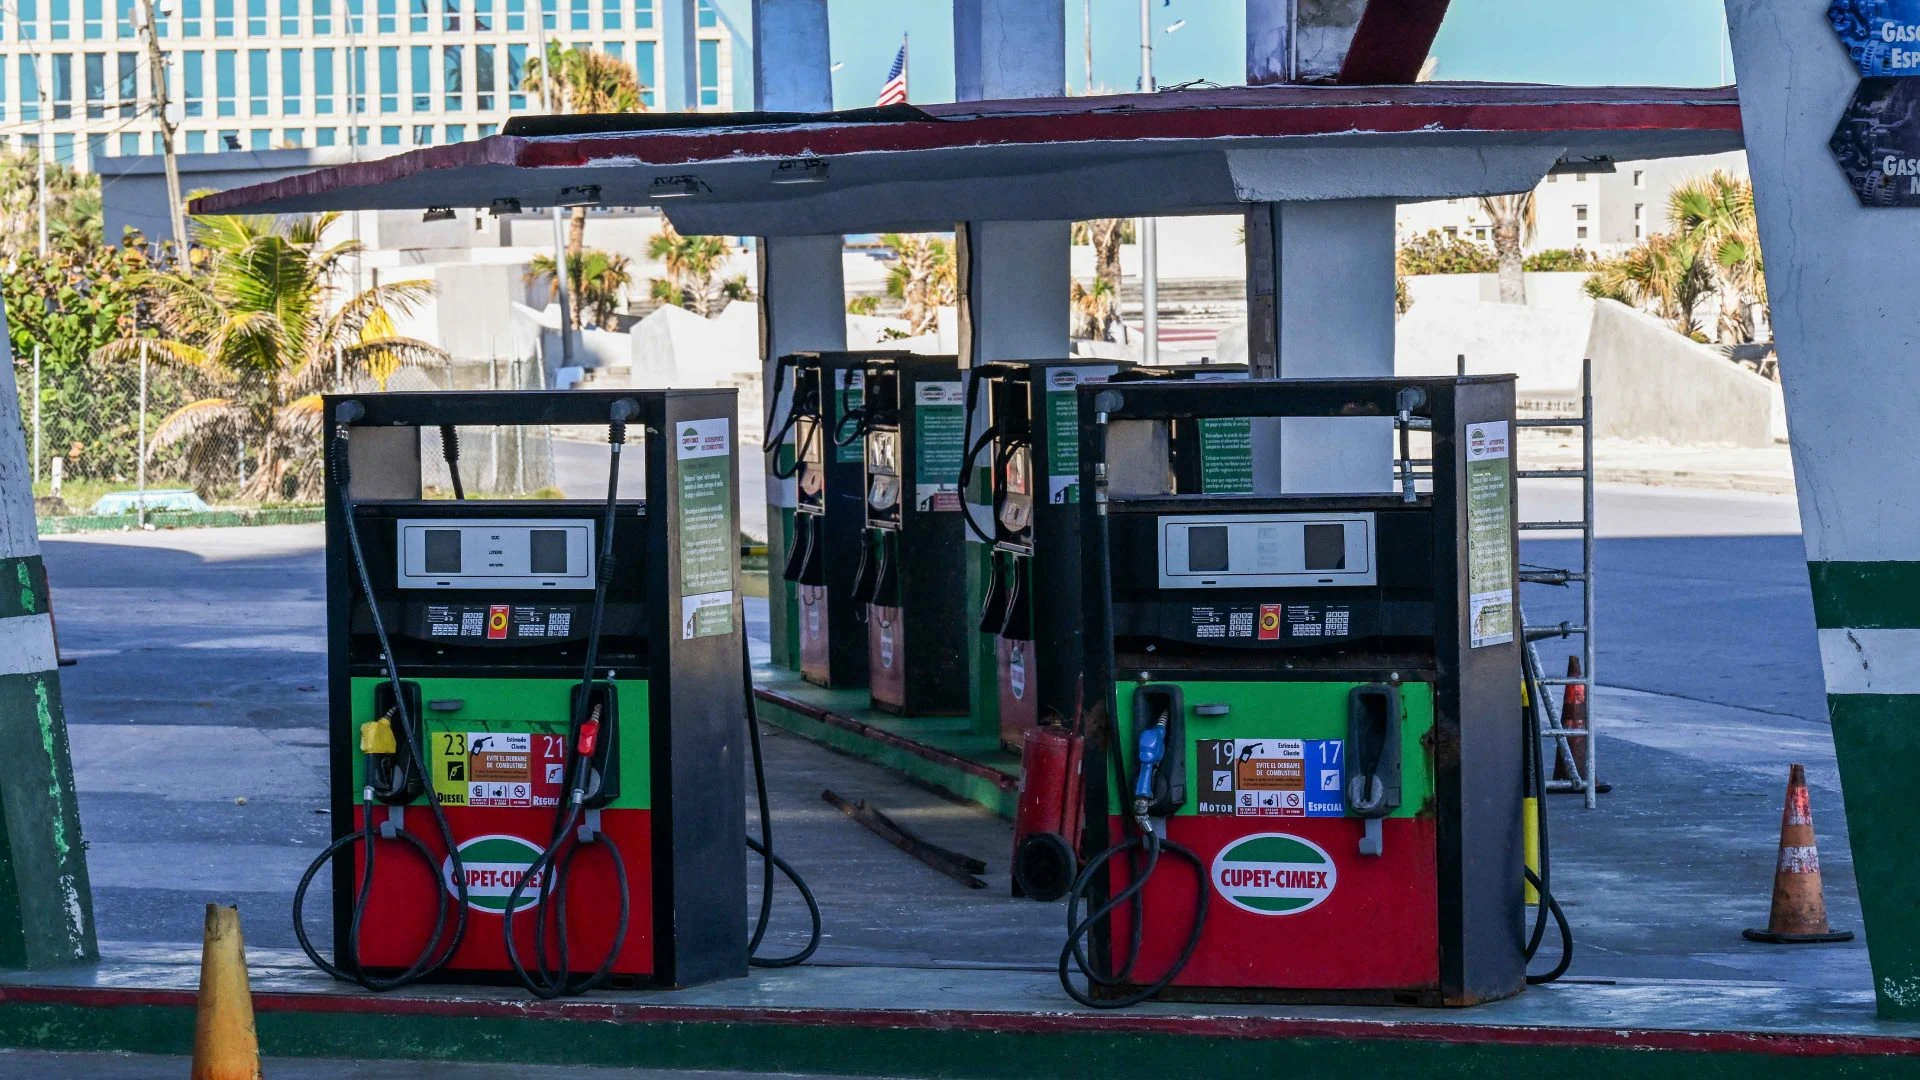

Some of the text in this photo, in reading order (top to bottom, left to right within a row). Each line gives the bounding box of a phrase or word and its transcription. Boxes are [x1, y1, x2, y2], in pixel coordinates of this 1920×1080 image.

[444, 733, 465, 756] 23
[543, 735, 563, 758] 21
[1212, 741, 1234, 766] 19
[1318, 740, 1342, 764] 17
[437, 792, 465, 804] DIESEL
[533, 795, 560, 806] REGUL
[1199, 802, 1233, 813] MOTOR
[1308, 801, 1343, 812] ESPECIAL
[1220, 868, 1328, 889] CUPET-CIMEX
